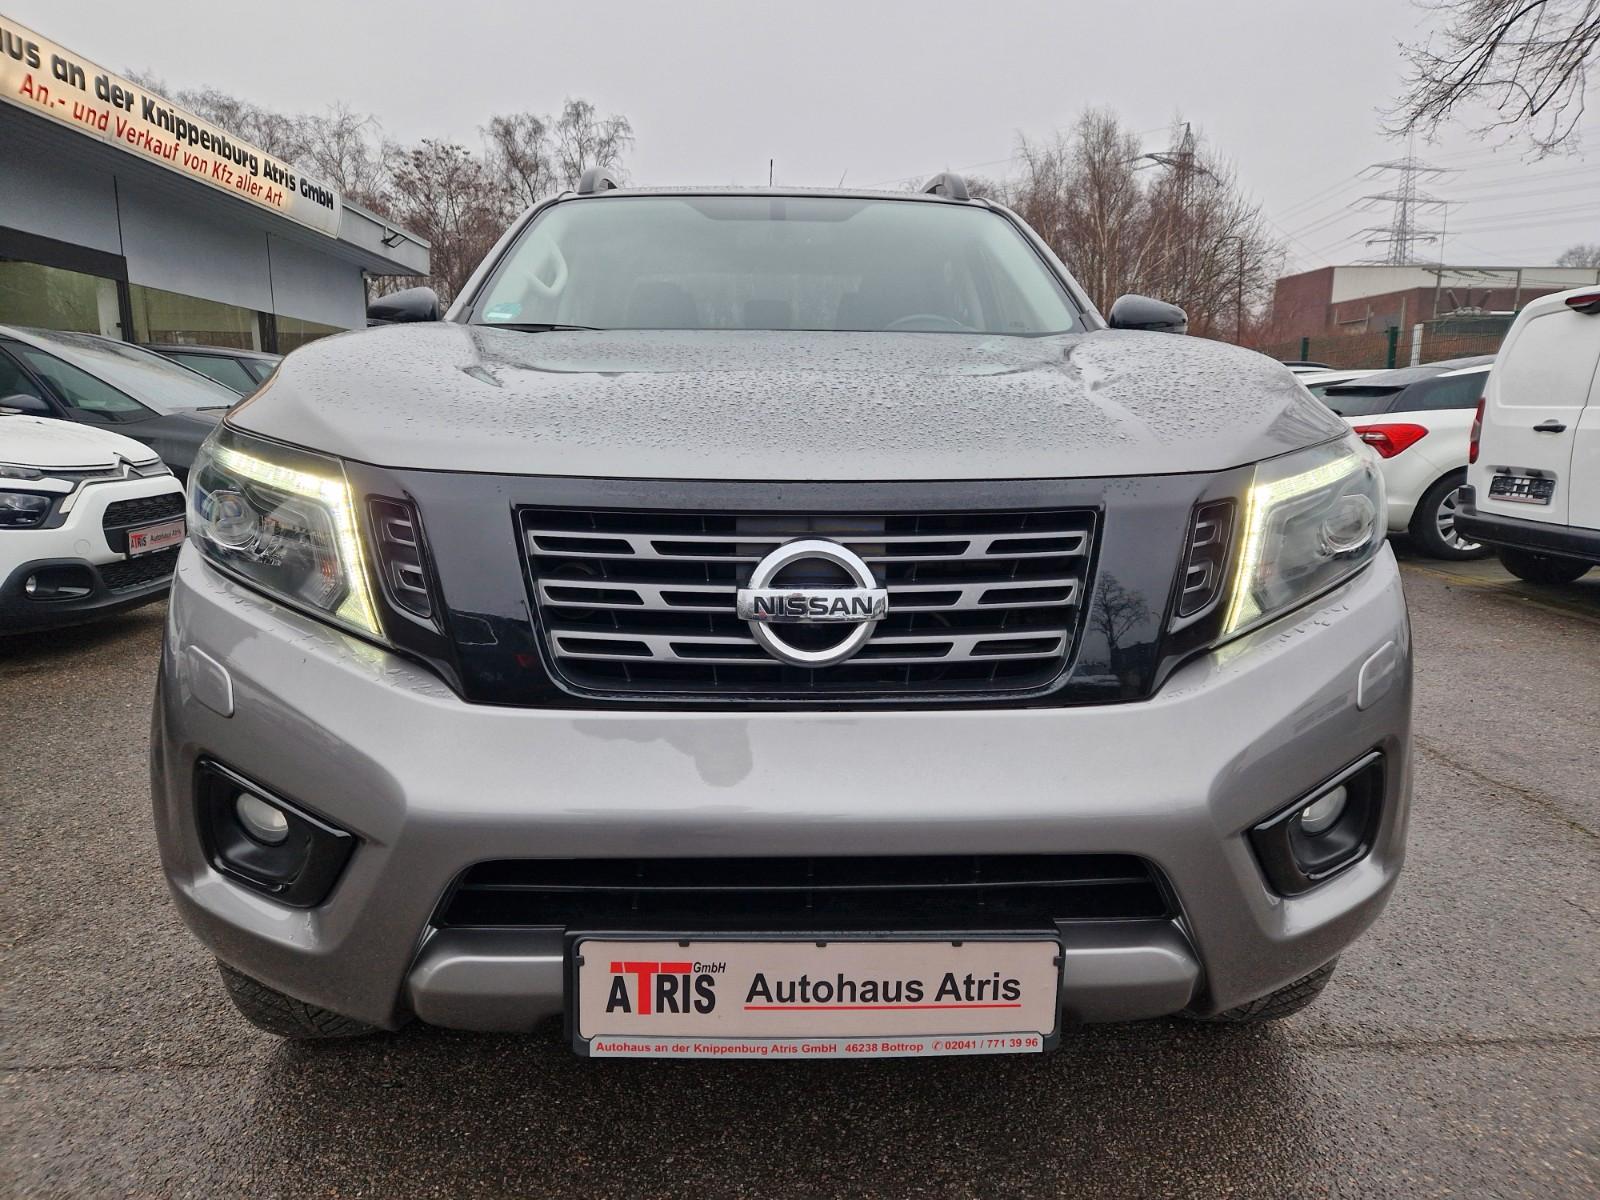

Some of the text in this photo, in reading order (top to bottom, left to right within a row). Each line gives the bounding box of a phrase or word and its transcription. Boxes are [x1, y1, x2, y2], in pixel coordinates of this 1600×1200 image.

[0, 28, 334, 210] us an der Knippenburg Atris GmbH
[72, 101, 110, 131] und
[116, 116, 180, 162] Verkauf
[184, 151, 208, 174] von
[212, 161, 233, 185] Kfz
[235, 174, 263, 197] aller
[265, 186, 283, 207] Art
[753, 596, 873, 616] NISSAN
[693, 961, 726, 973] GmbH
[606, 962, 716, 1015] ATRIS
[745, 972, 1021, 1003] Autohaus Atris
[596, 1042, 650, 1052] Autohaus
[654, 1044, 668, 1053] an
[672, 1043, 689, 1053] der
[694, 1044, 768, 1055] Knippenburg
[771, 1044, 798, 1054] Atris
[802, 1043, 837, 1054] GmbH
[845, 1043, 877, 1052] 46238
[881, 1042, 924, 1053] Bottrop
[945, 1040, 976, 1050] 02041
[987, 1039, 1005, 1048] 771
[1009, 1038, 1022, 1047] 39
[1025, 1038, 1038, 1047] 96
